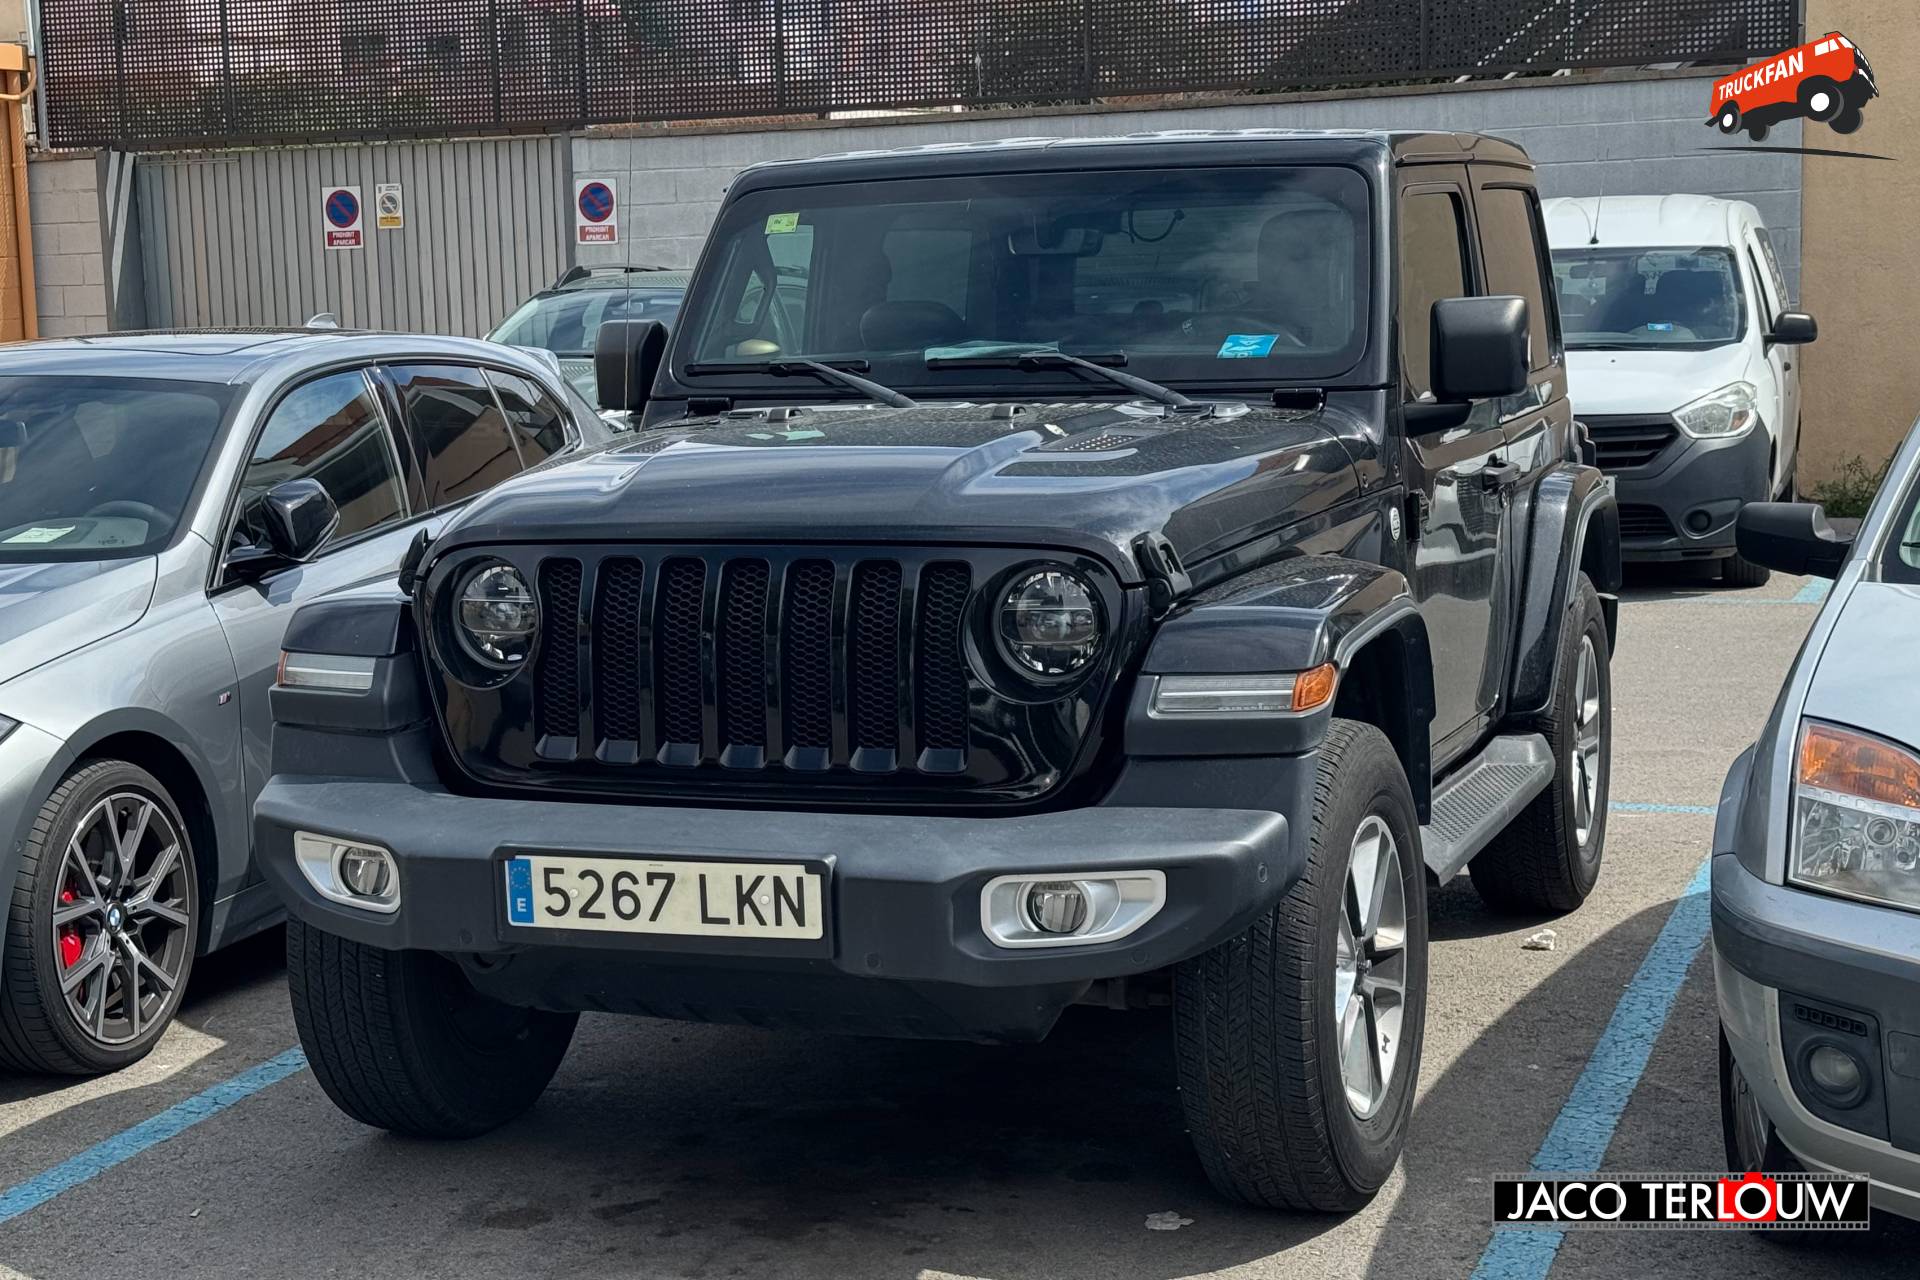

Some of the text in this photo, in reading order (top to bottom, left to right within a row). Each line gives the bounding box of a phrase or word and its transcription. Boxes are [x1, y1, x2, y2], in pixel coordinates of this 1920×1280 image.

[516, 898, 527, 912] E
[543, 868, 806, 927] 5267 LKN
